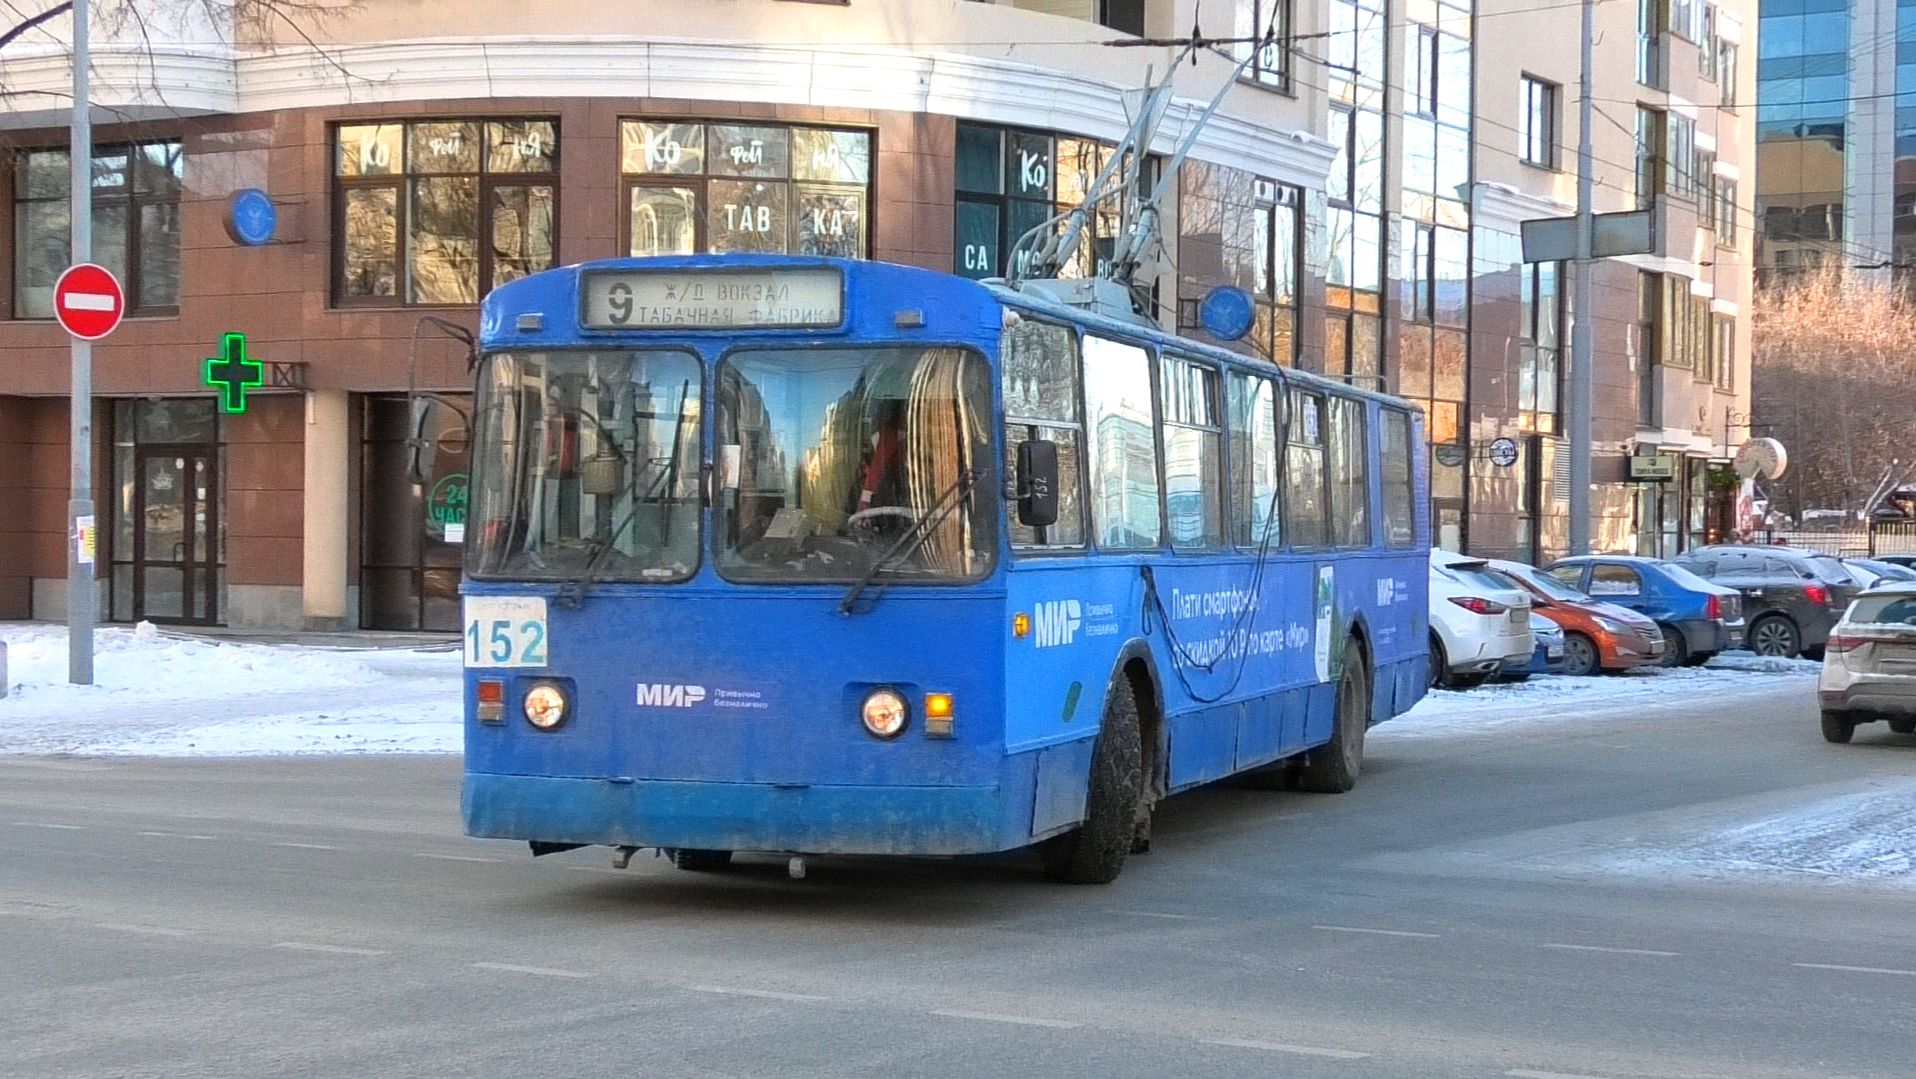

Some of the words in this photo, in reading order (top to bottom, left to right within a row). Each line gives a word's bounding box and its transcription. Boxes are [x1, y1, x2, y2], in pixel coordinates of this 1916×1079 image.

[724, 204, 771, 232] ТАВ
[814, 208, 844, 236] КА
[965, 244, 989, 271] СА
[608, 282, 634, 325] 9
[665, 283, 704, 301] Ж/Д
[717, 284, 790, 301] ВОКЗАЛ
[639, 306, 734, 324] ТАБАЧНАЯ
[750, 307, 836, 324] ФАБРИКА
[1034, 476, 1049, 499] 152
[434, 507, 466, 523] ЧАС
[1172, 588, 1202, 620] Плати
[1035, 599, 1081, 648] МИР
[467, 619, 545, 663] 152
[1260, 629, 1284, 658] карте
[636, 683, 706, 707] МИР
